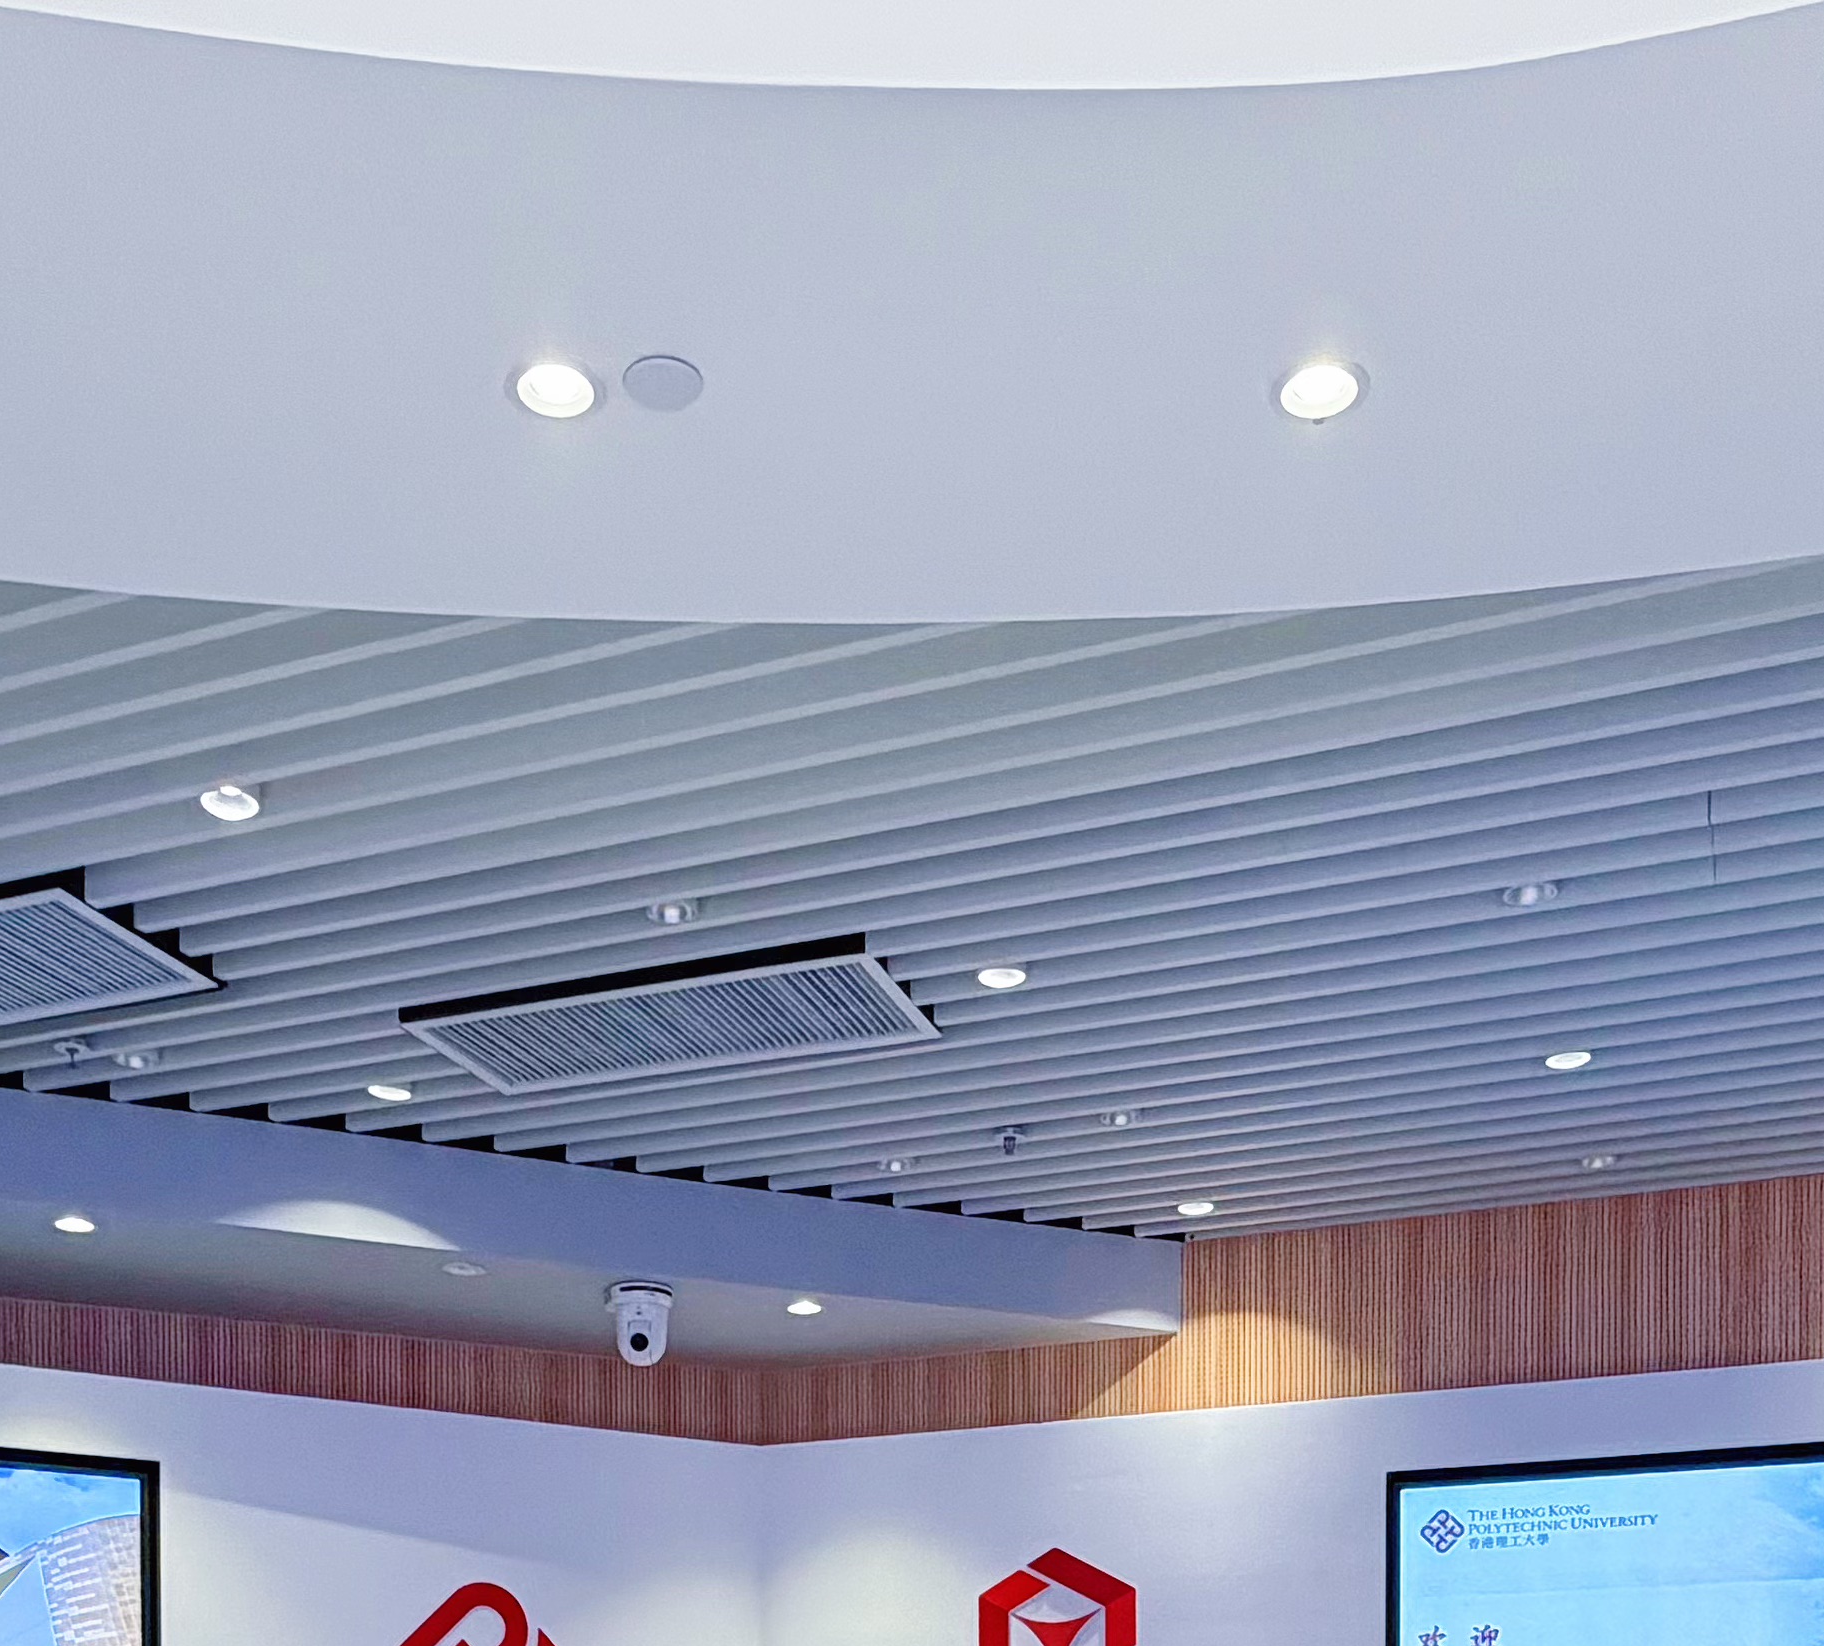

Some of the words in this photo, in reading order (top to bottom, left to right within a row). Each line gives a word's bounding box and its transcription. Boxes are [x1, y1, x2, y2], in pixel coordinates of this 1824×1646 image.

[1467, 1509, 1498, 1522] THE
[1501, 1506, 1545, 1520] HONG
[1548, 1504, 1591, 1518] KONG
[1468, 1519, 1568, 1535] POLYTECHNIC
[1571, 1514, 1658, 1530] UNIVERSITY
